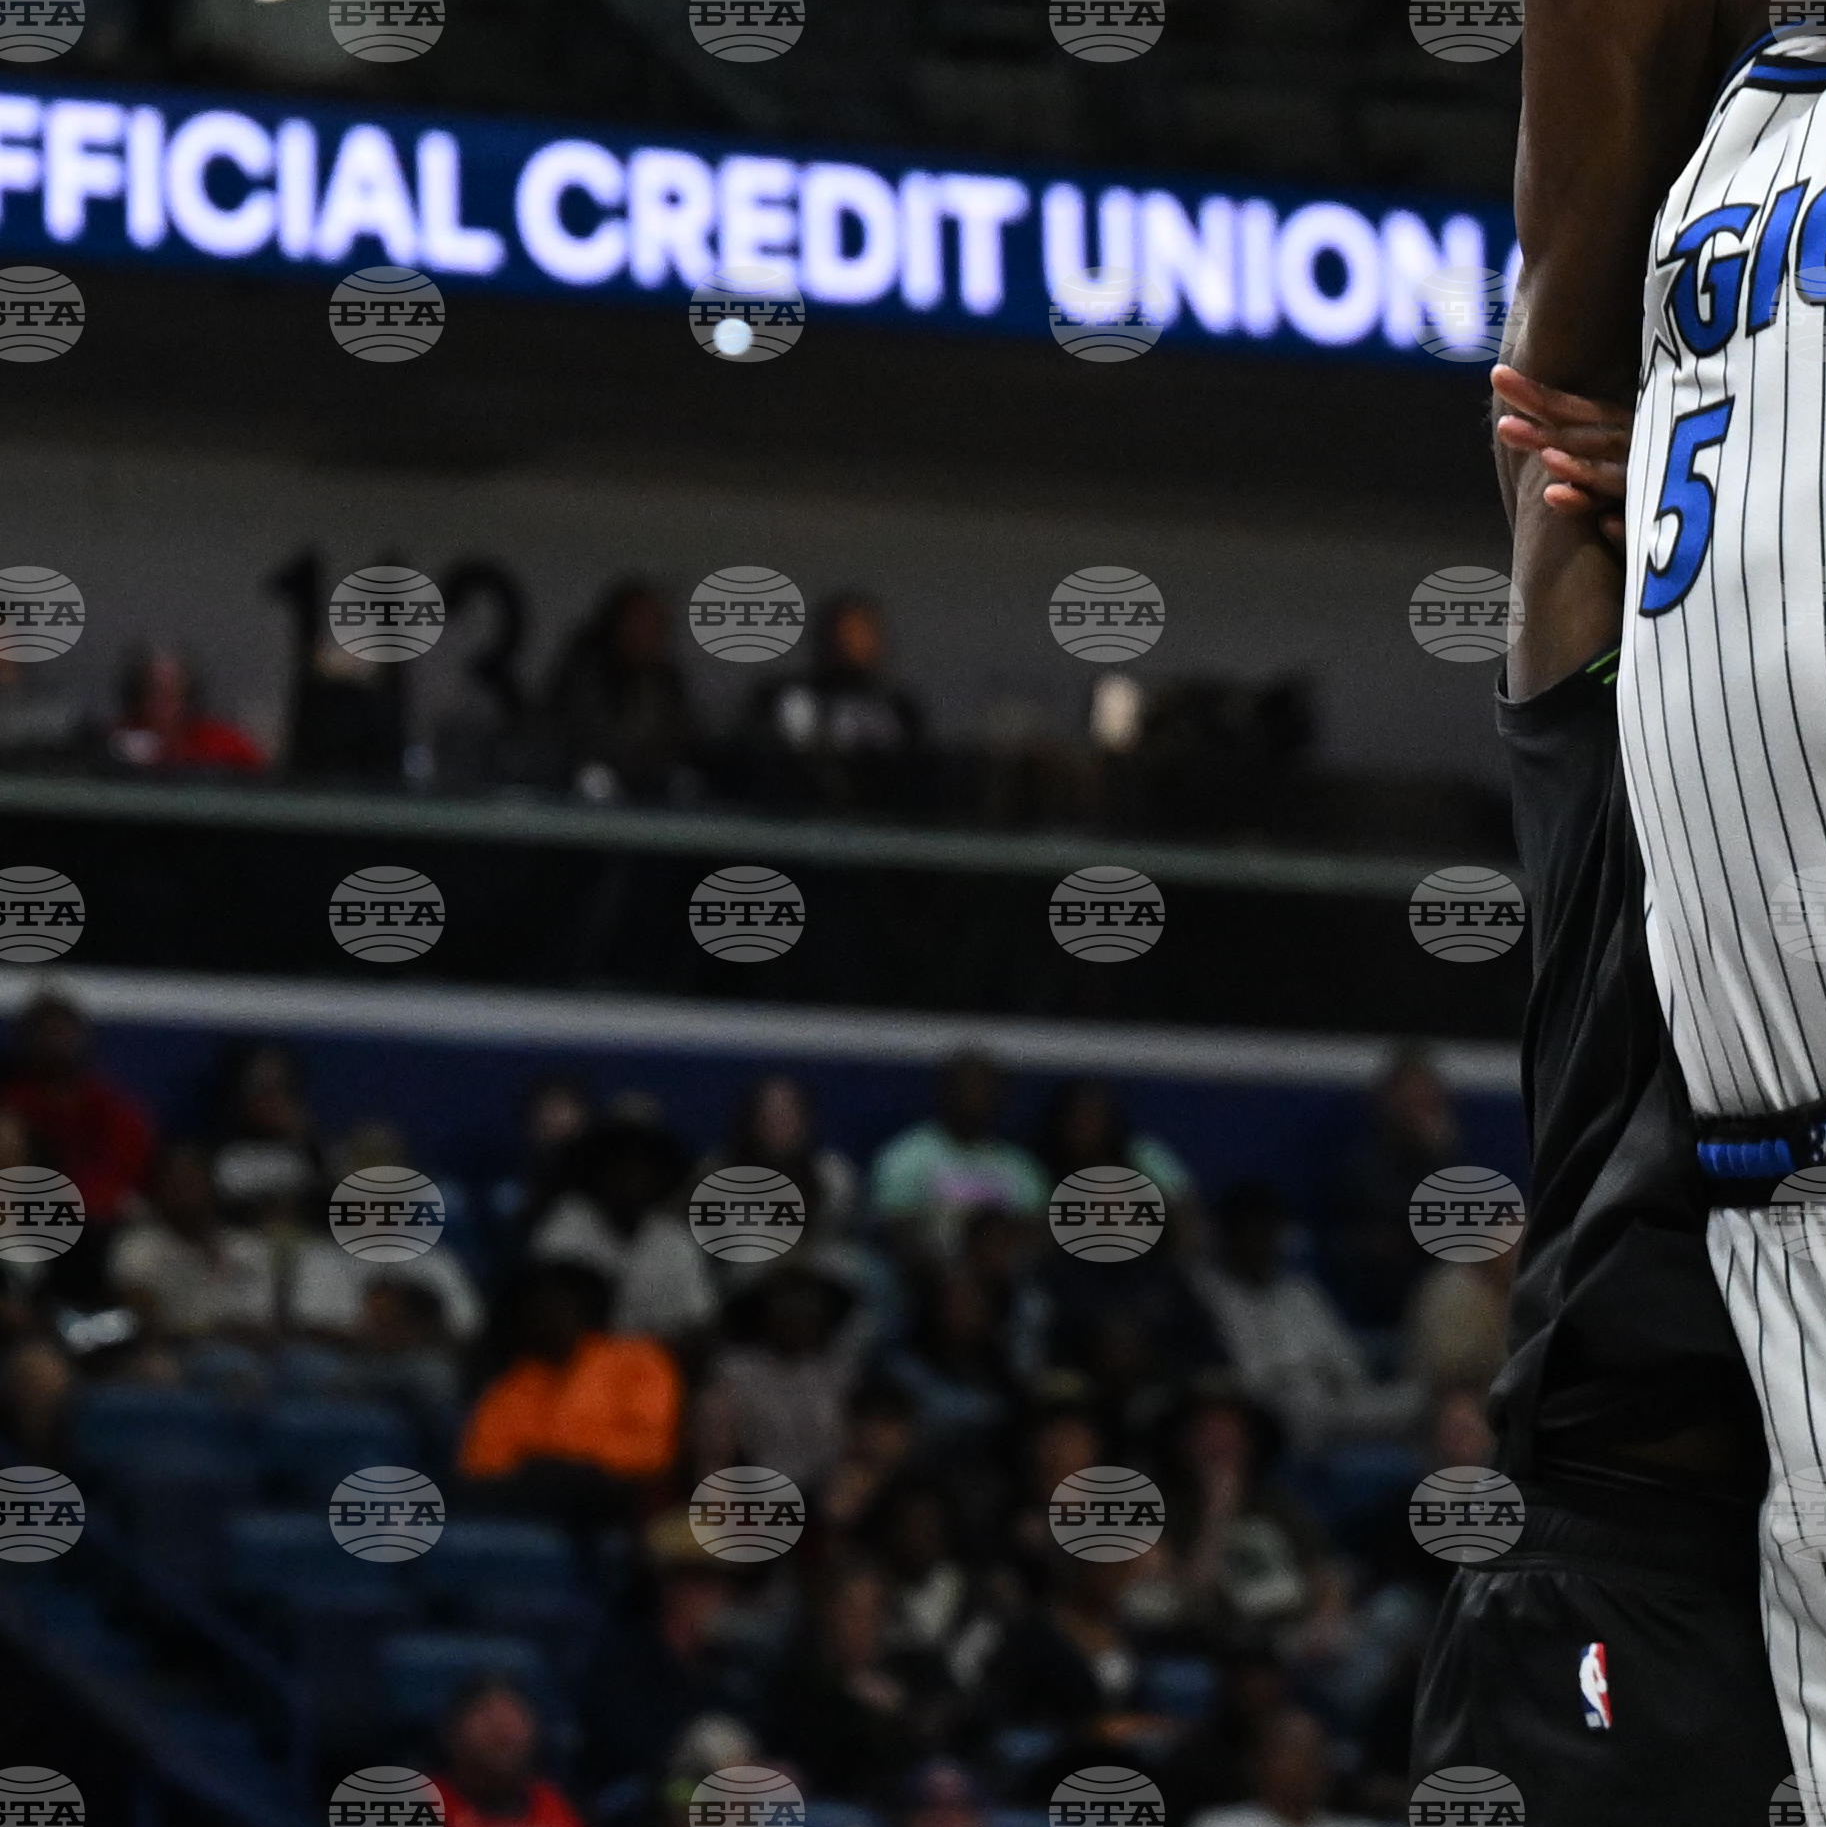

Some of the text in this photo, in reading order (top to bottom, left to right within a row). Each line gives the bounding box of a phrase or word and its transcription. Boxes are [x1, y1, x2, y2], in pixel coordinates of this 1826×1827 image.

[515, 139, 1029, 317] CREDIT
[1041, 182, 1487, 354] UNION
[1638, 395, 1736, 618] 5
